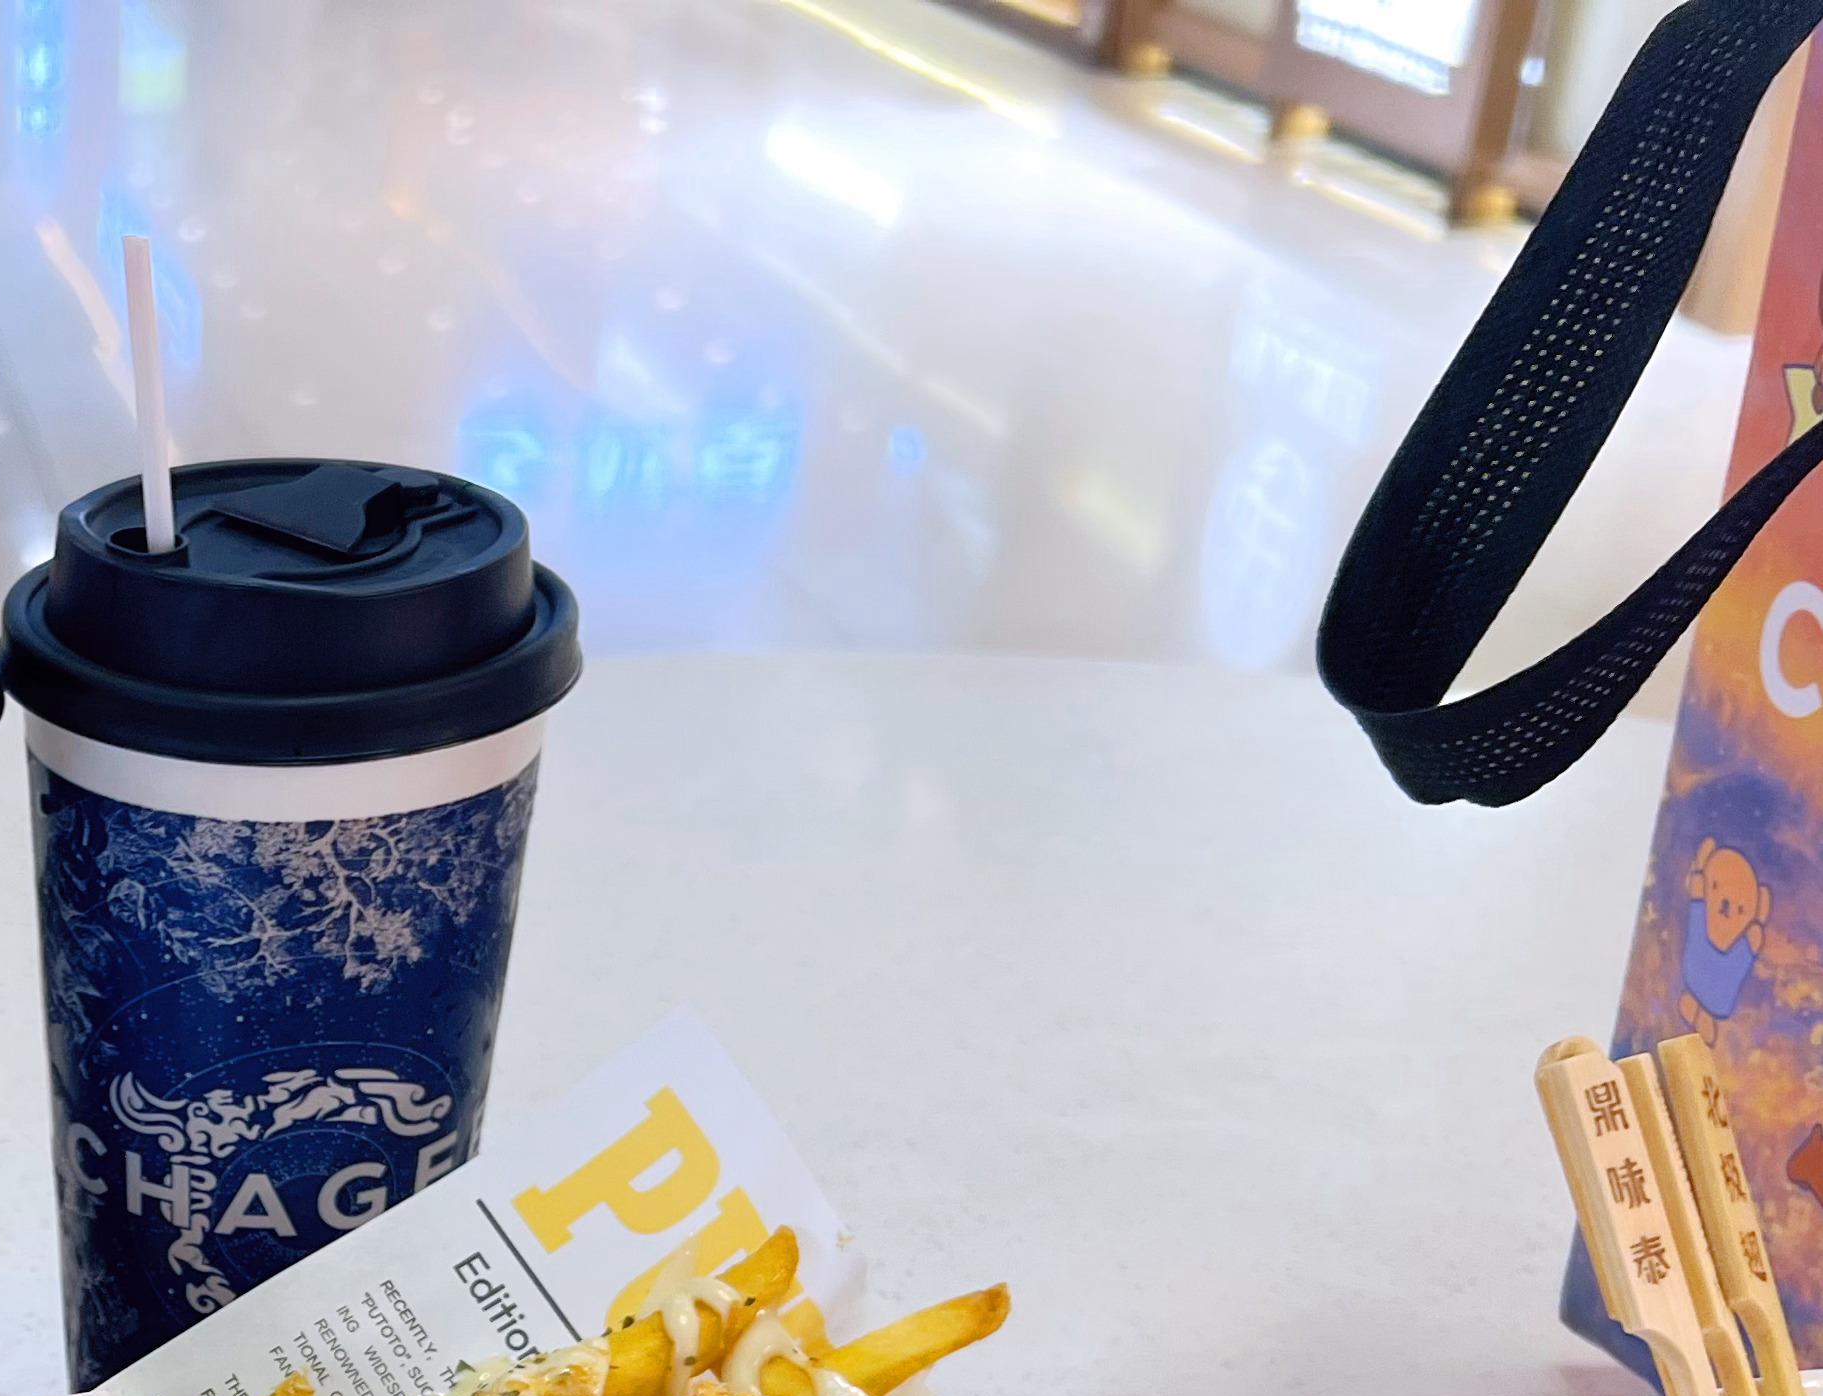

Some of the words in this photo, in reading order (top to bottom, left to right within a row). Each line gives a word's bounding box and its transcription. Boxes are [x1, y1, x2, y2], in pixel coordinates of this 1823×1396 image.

[69, 1110, 482, 1237] CHAGE
[1585, 1080, 1671, 1284] 鼎味泰
[293, 1331, 330, 1386] TIONAL
[336, 1305, 360, 1334] ING
[379, 1279, 438, 1362] RECENTLY,
